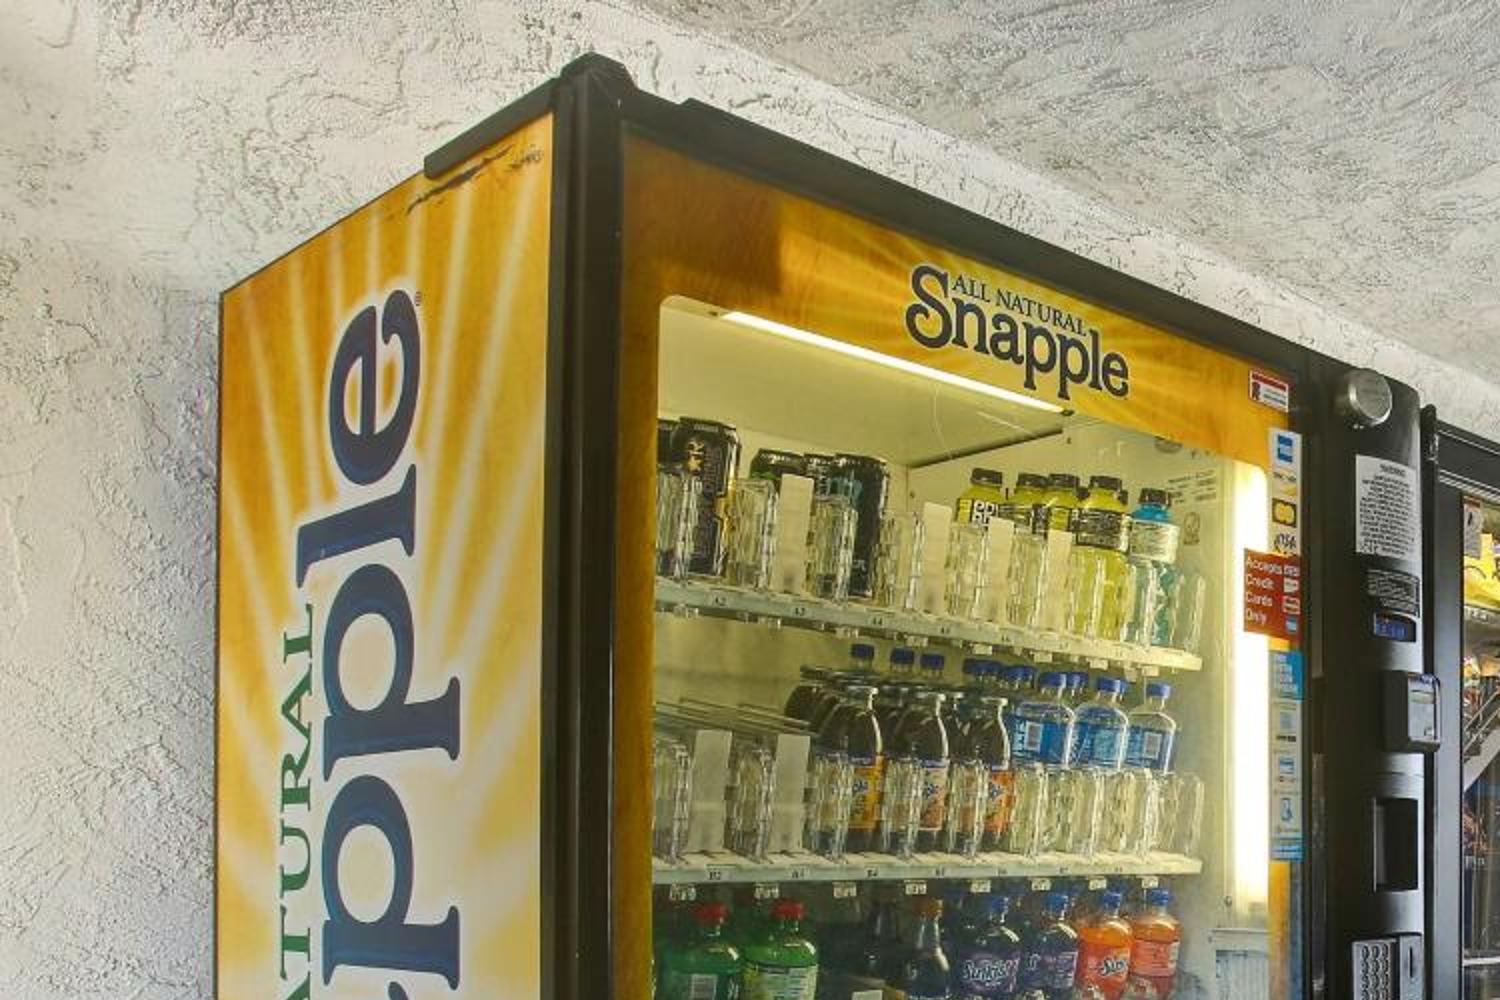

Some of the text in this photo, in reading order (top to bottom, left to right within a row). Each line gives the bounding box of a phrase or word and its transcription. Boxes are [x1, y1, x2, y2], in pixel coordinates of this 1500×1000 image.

[905, 265, 1129, 400] Snapple
[952, 274, 1087, 338] ALL NATURAL
